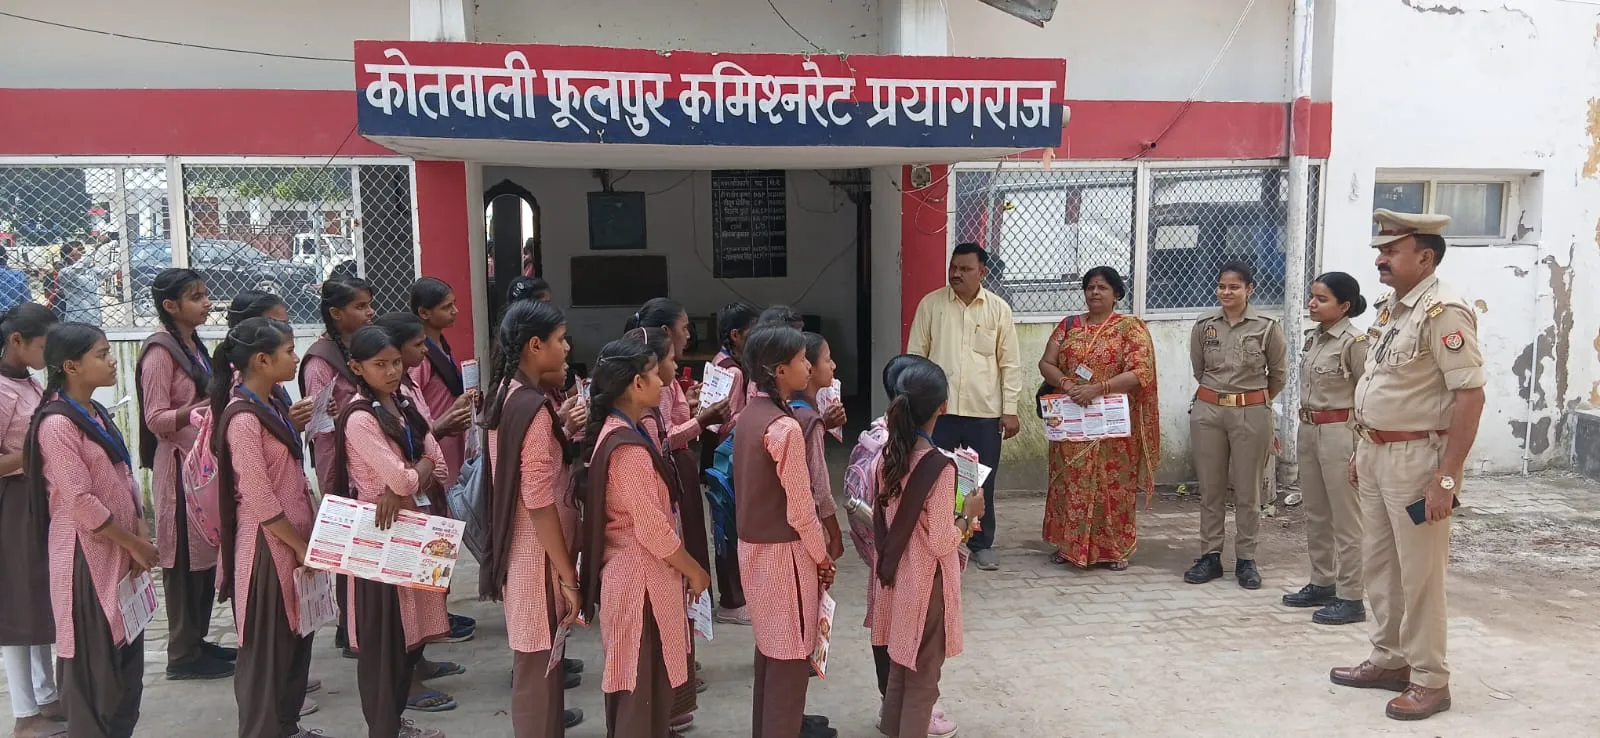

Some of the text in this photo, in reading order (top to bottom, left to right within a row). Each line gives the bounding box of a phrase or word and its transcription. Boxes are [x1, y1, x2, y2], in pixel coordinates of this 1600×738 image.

[364, 48, 1057, 137] कोतवाली फूलपुर कमिश्नरेट प्रयागराज
